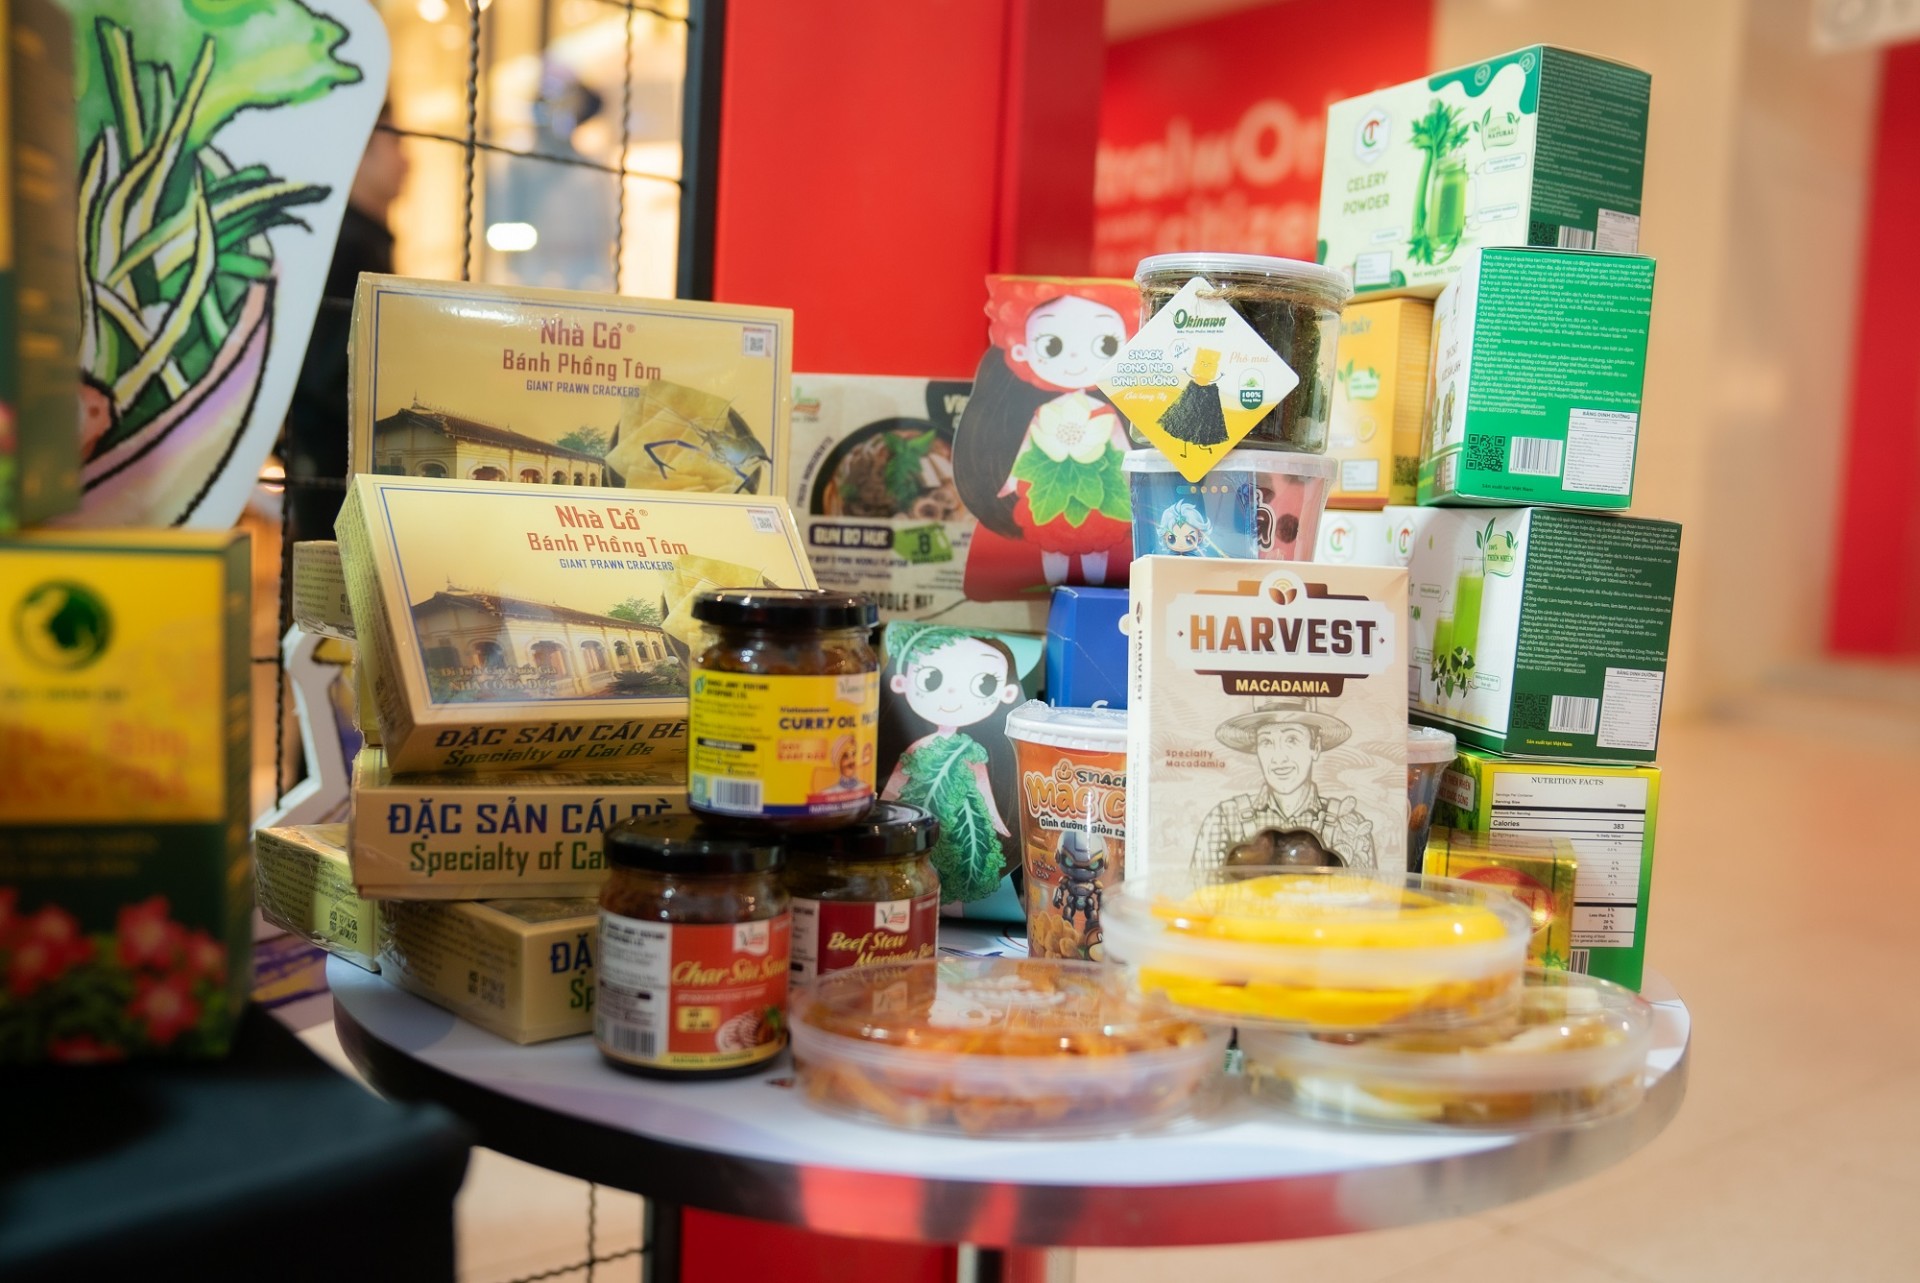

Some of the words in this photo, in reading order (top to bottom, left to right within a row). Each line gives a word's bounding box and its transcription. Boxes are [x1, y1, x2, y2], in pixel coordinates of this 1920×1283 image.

[1488, 128, 1514, 139] NATURAL
[1346, 170, 1388, 192] CELERY
[1343, 193, 1390, 214] POWDER
[1172, 308, 1228, 330] Okinawa
[541, 318, 584, 347] Nhà
[503, 349, 550, 372] Bánh
[558, 353, 617, 382] Phồng
[622, 358, 661, 381] Tôm
[1128, 350, 1162, 360] SNACK
[1117, 363, 1146, 373] RONG
[1149, 363, 1173, 373] NHO
[526, 380, 554, 392] GIANT
[556, 382, 590, 394] PRAWN
[592, 385, 640, 398] CRACKERS
[1112, 376, 1138, 386] DINH
[1140, 374, 1179, 387] DƯỠNG
[555, 505, 604, 529] Nhà
[527, 532, 579, 552] Bánh
[583, 534, 647, 558] Phồng
[647, 536, 689, 555] Tôm
[560, 558, 588, 569] GIANT
[590, 560, 624, 570] PRAWN
[626, 560, 674, 571] CRACKERS
[1190, 614, 1377, 656] HARVEST
[1236, 678, 1330, 694] MACADAMIA
[436, 726, 508, 749] ĐẶC
[513, 721, 584, 745] SẢN
[588, 720, 640, 741] CÁI
[648, 718, 688, 739] BÈ
[779, 716, 835, 730] CURRY
[837, 716, 856, 729] OIL
[444, 746, 553, 767] Specialty
[556, 746, 582, 760] of
[589, 743, 622, 758] Cai
[630, 742, 655, 757] Be
[1166, 748, 1214, 758] Specialty
[1166, 760, 1226, 768] Macadamia
[1531, 776, 1577, 785] NUTRITION
[387, 798, 462, 839] ĐẶC
[476, 796, 548, 834] SẢN
[1092, 824, 1112, 834] giòn
[410, 842, 529, 877] Specialty
[538, 842, 564, 871] of
[827, 931, 872, 955] Beef
[868, 930, 908, 951] Stew
[550, 932, 594, 976] ĐẶ
[672, 960, 730, 986] Char
[726, 958, 760, 984] Siu
